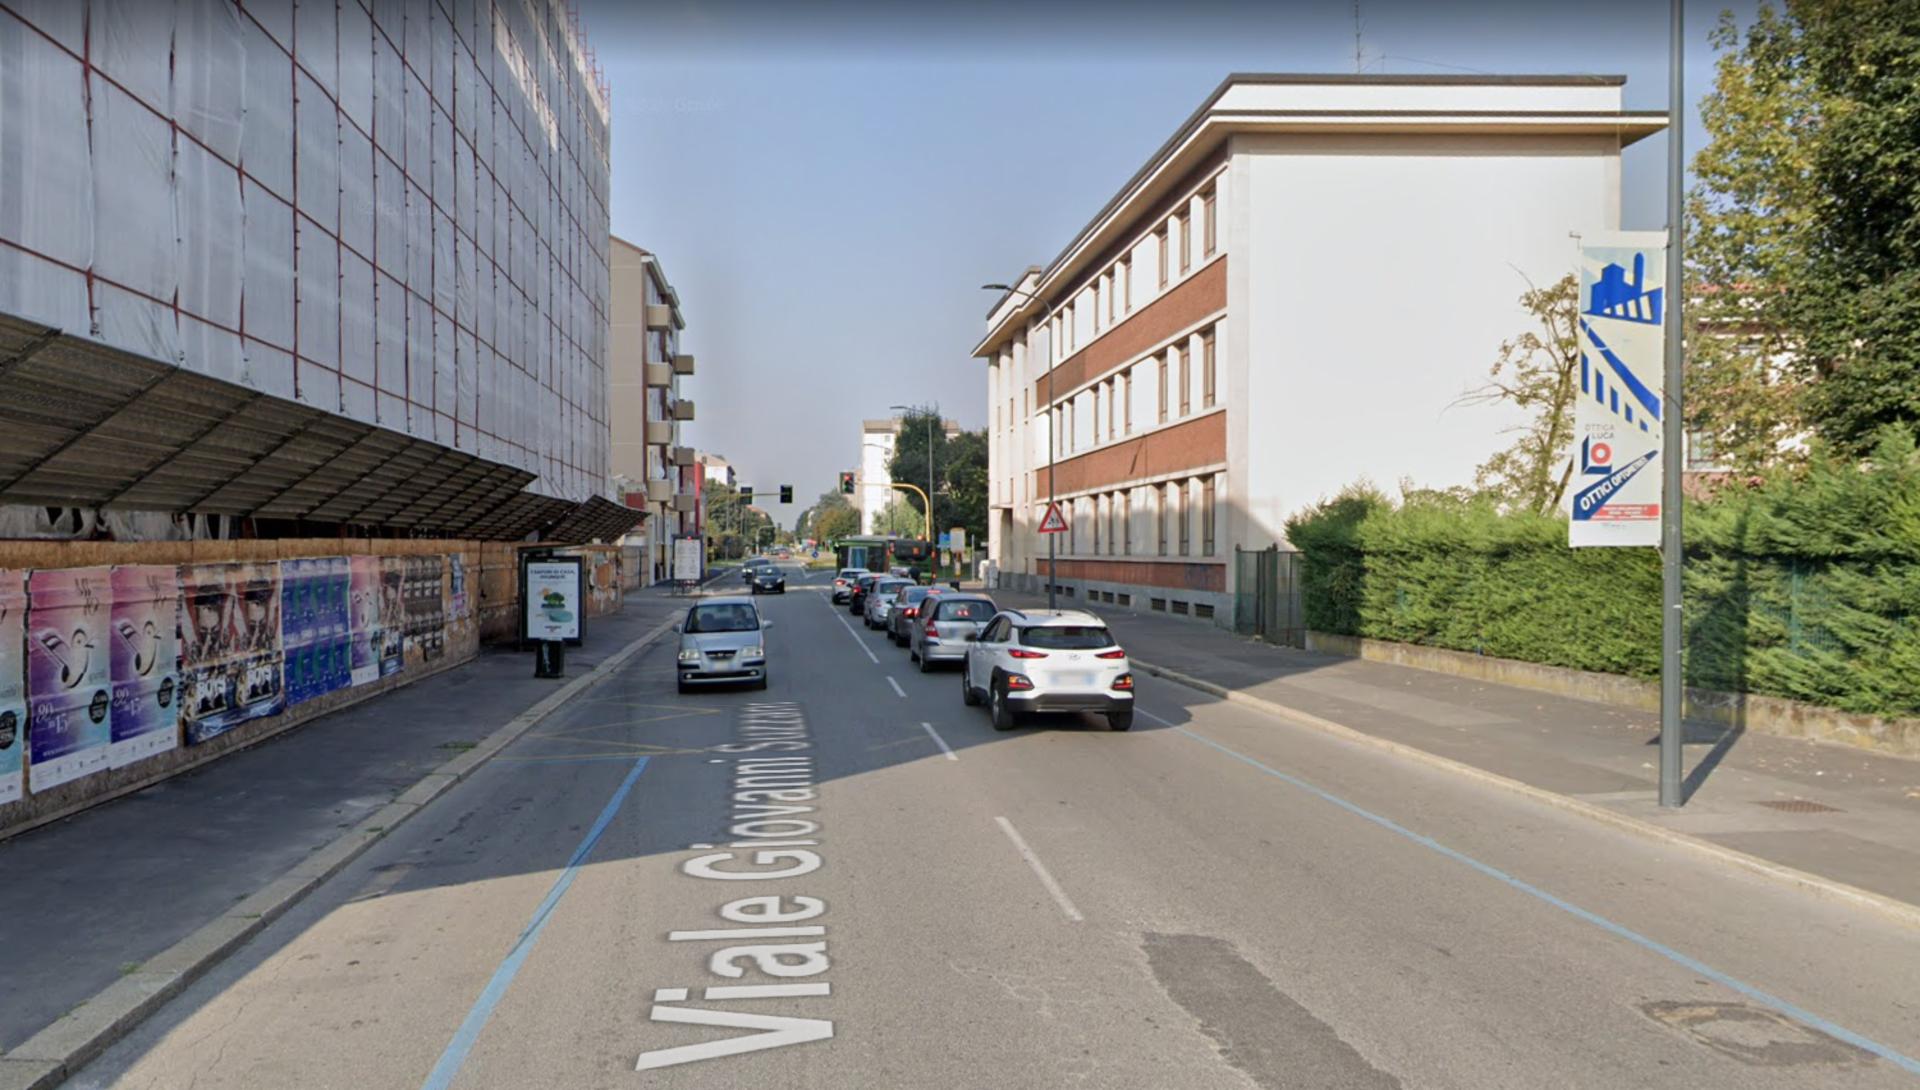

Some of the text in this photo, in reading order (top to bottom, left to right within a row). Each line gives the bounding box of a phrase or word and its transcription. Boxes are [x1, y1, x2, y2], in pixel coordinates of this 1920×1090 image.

[1584, 423, 1615, 432] OTTICA
[1591, 431, 1615, 440] LUCA
[1580, 480, 1613, 511] OTTICI
